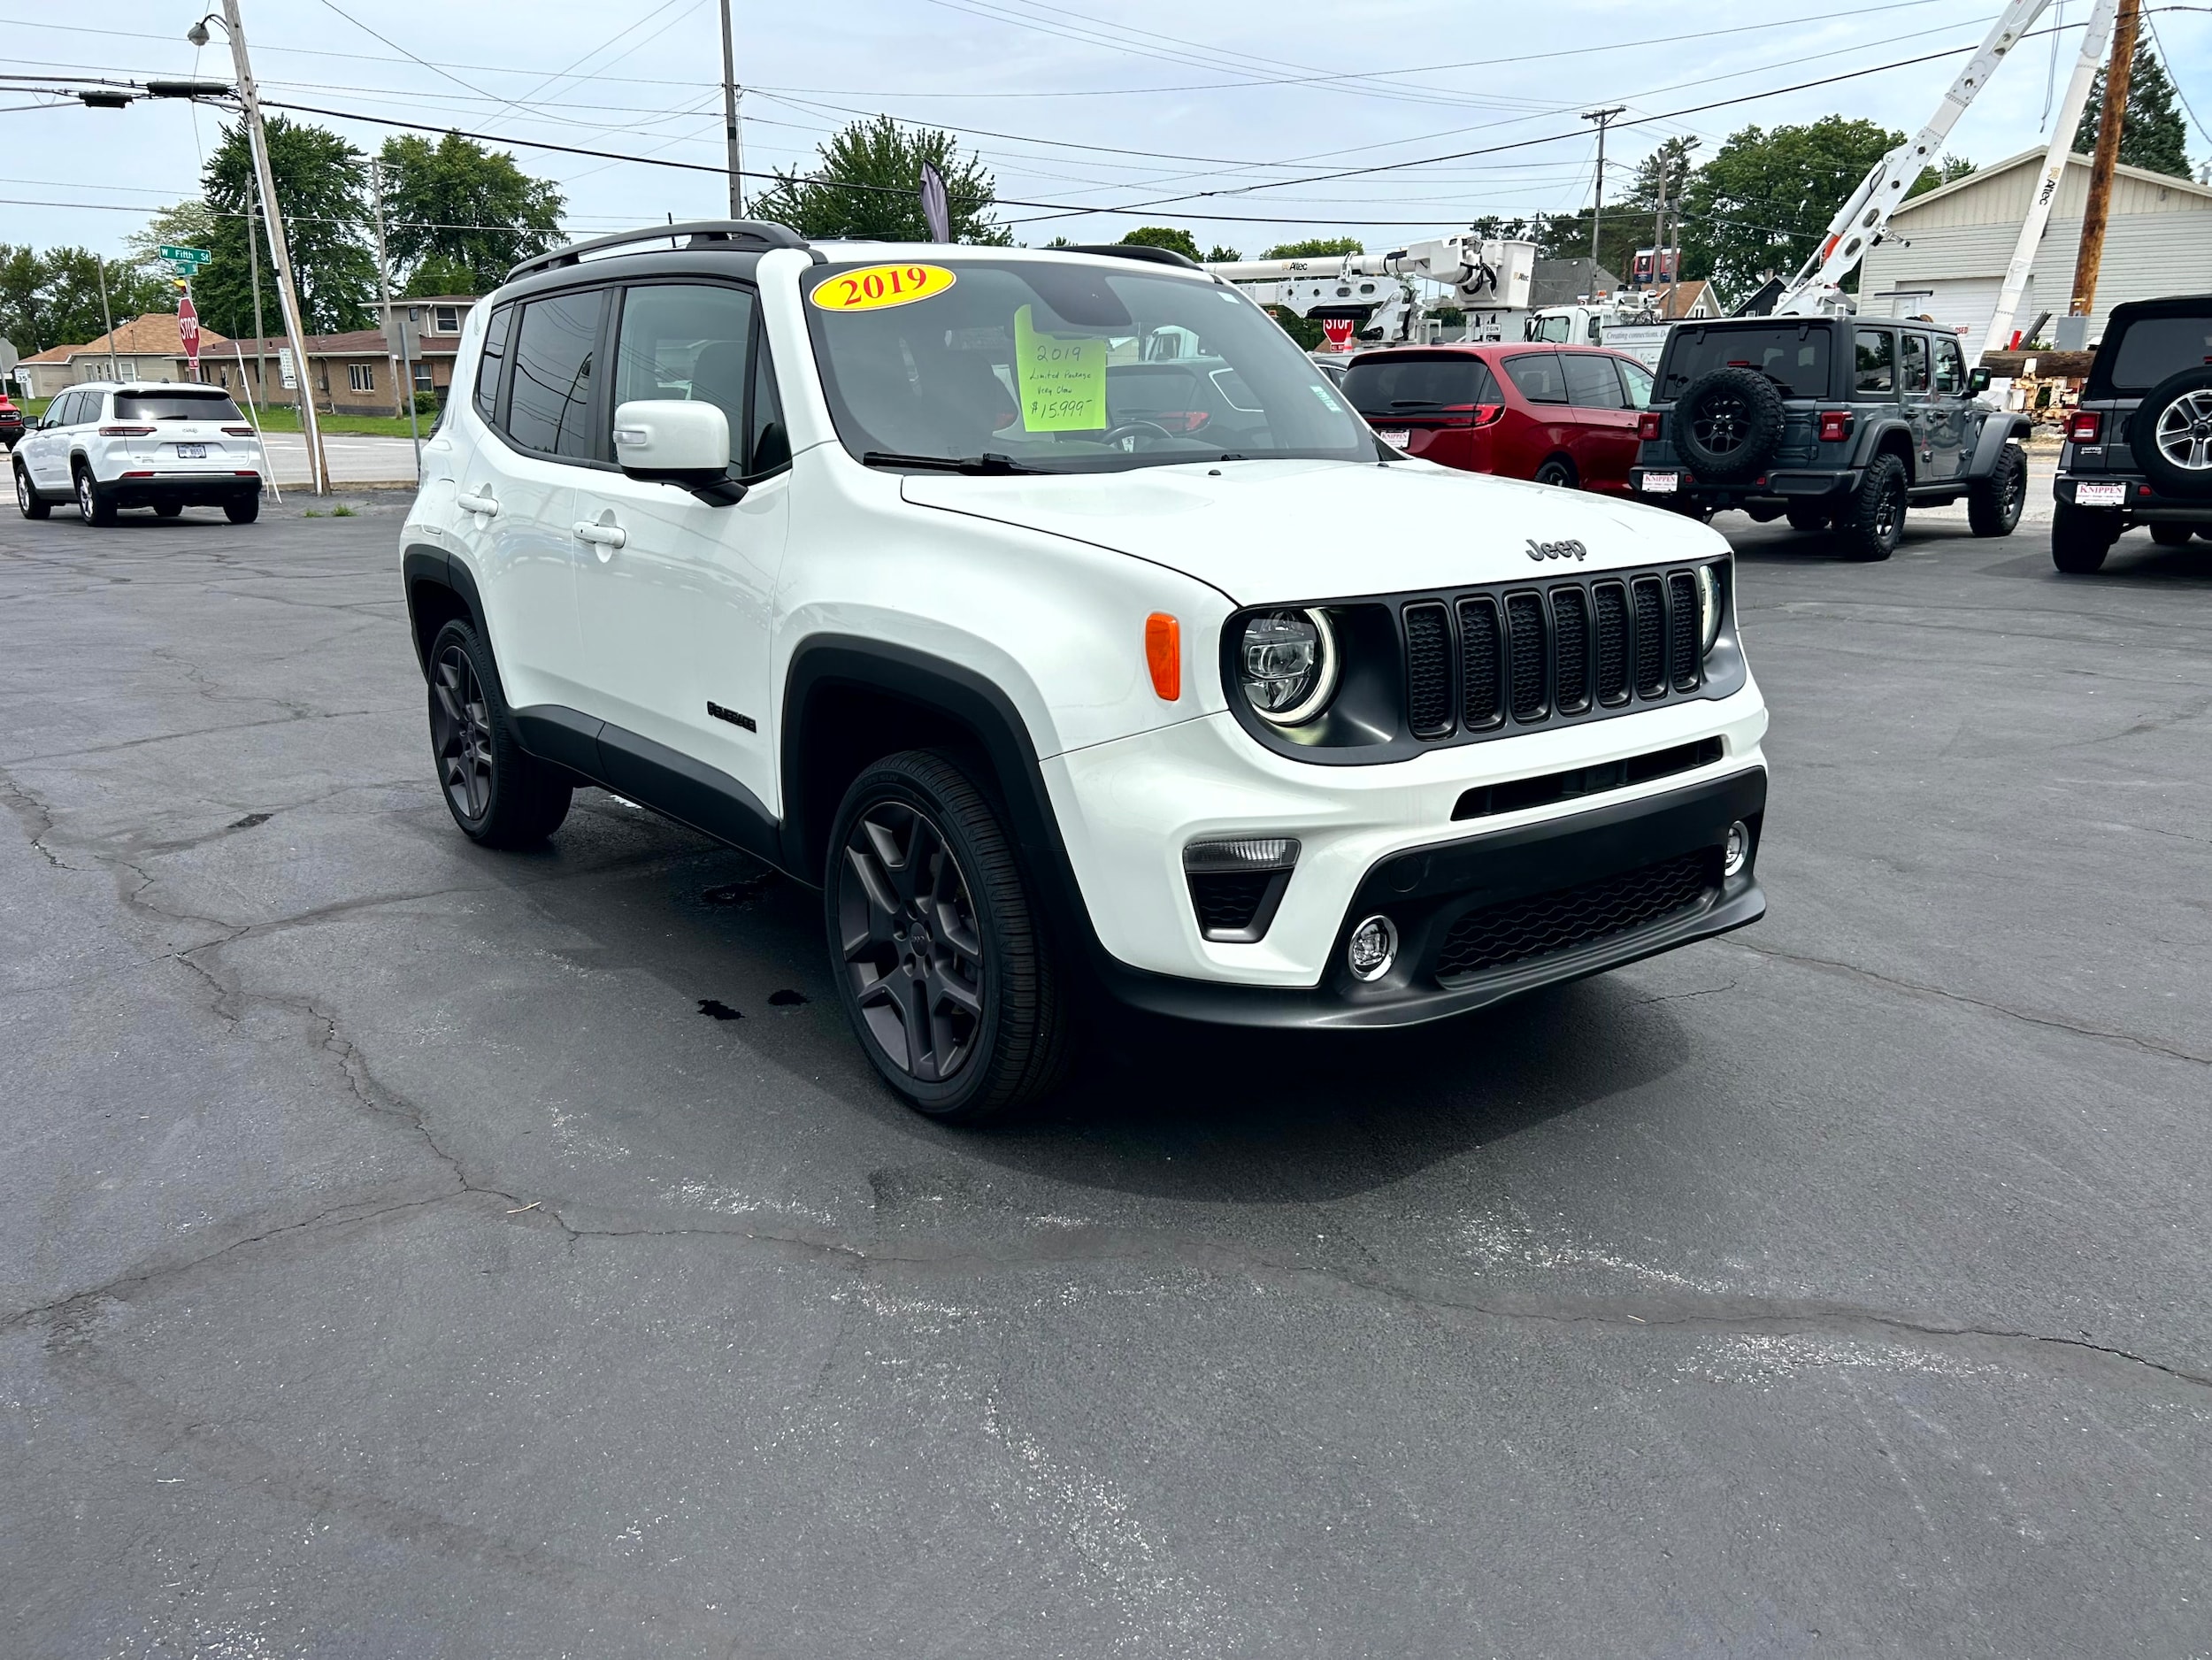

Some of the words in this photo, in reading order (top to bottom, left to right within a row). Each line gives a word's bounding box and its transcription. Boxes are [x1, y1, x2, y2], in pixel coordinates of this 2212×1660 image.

[2039, 179, 2055, 205] Altec
[161, 248, 169, 257] W
[175, 250, 194, 259] Fifth
[201, 252, 210, 262] St
[1289, 262, 1308, 271] Altec
[840, 267, 927, 306] 2019
[180, 317, 198, 340] STOP
[1325, 319, 1351, 330] STOP
[1607, 331, 1628, 341] Creating
[1037, 345, 1081, 362] 2019
[1525, 539, 1586, 562] Jeep
